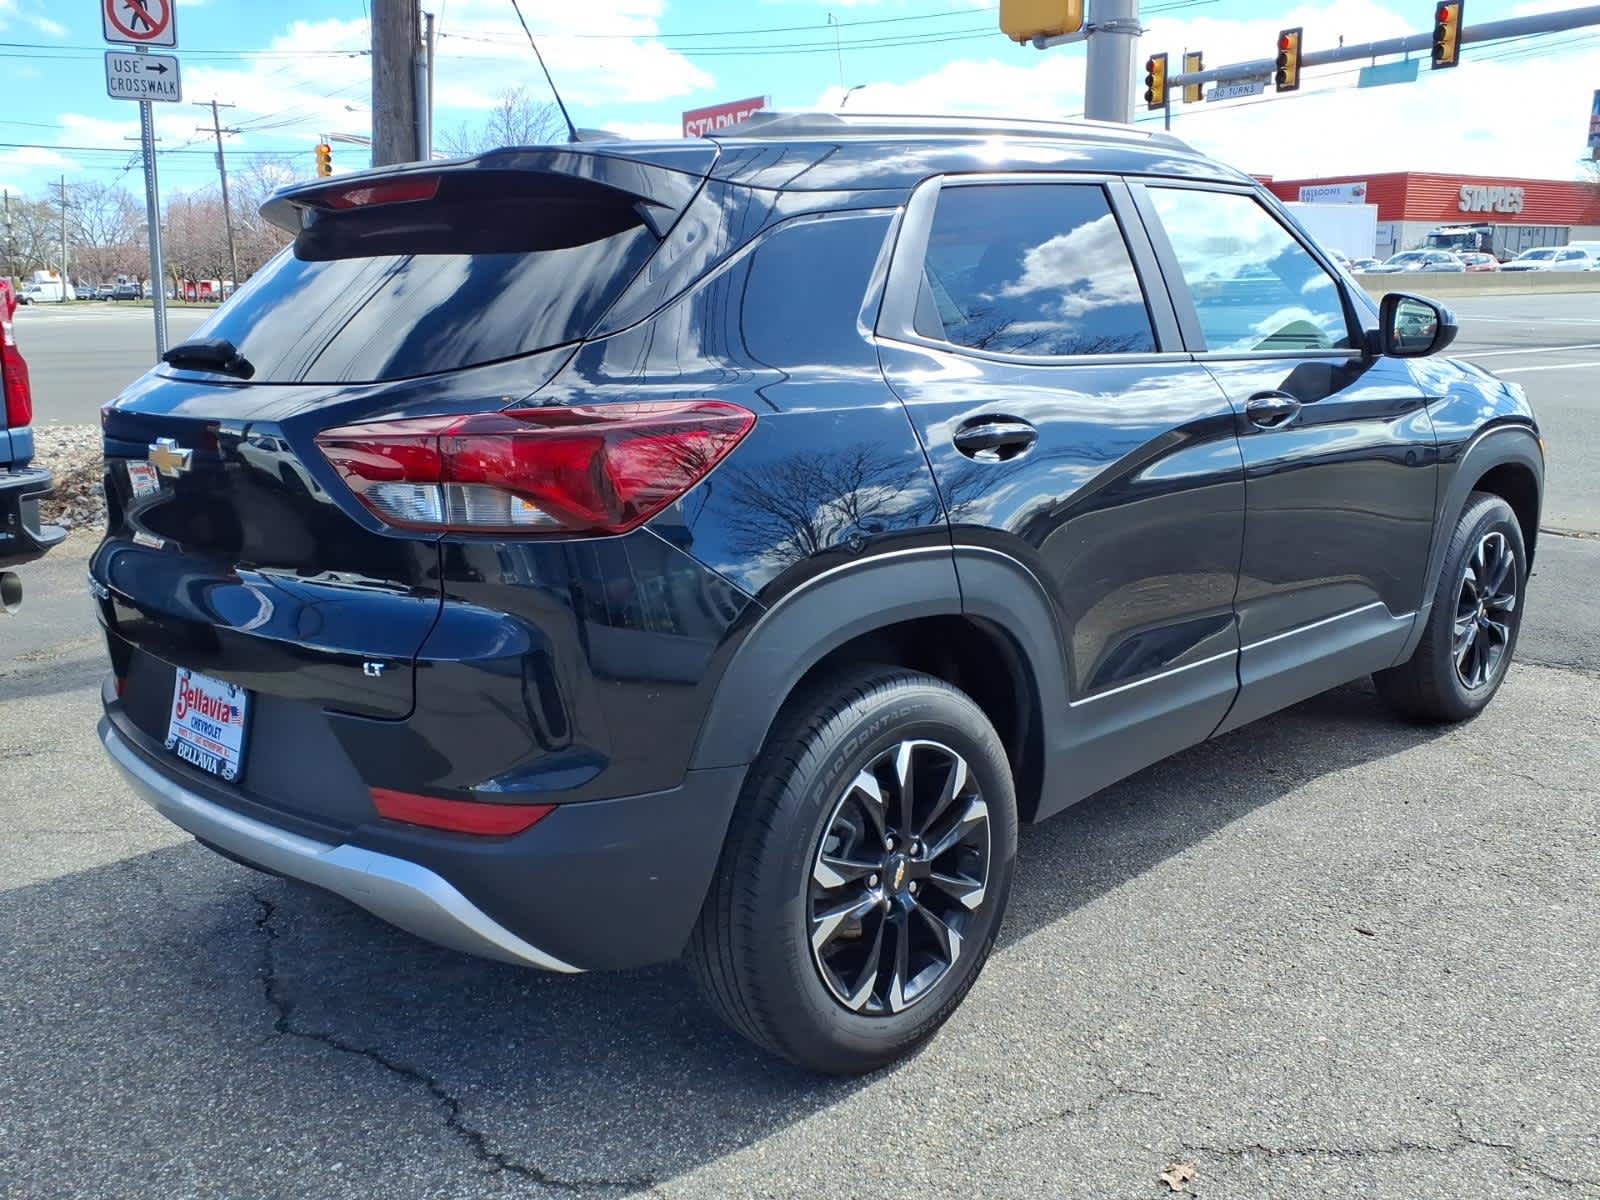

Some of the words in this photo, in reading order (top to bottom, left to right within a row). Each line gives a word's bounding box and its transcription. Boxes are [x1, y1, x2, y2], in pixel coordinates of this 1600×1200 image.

[114, 59, 141, 73] USE
[110, 77, 176, 95] CROSSWALK
[1214, 89, 1225, 98] NO
[1229, 85, 1255, 96] TURNS
[1459, 185, 1525, 213] STAPLES
[363, 662, 385, 677] LT
[176, 678, 231, 723] Bellavia
[191, 717, 222, 740] CHEVROLET
[177, 743, 217, 774] BELLAVIA
